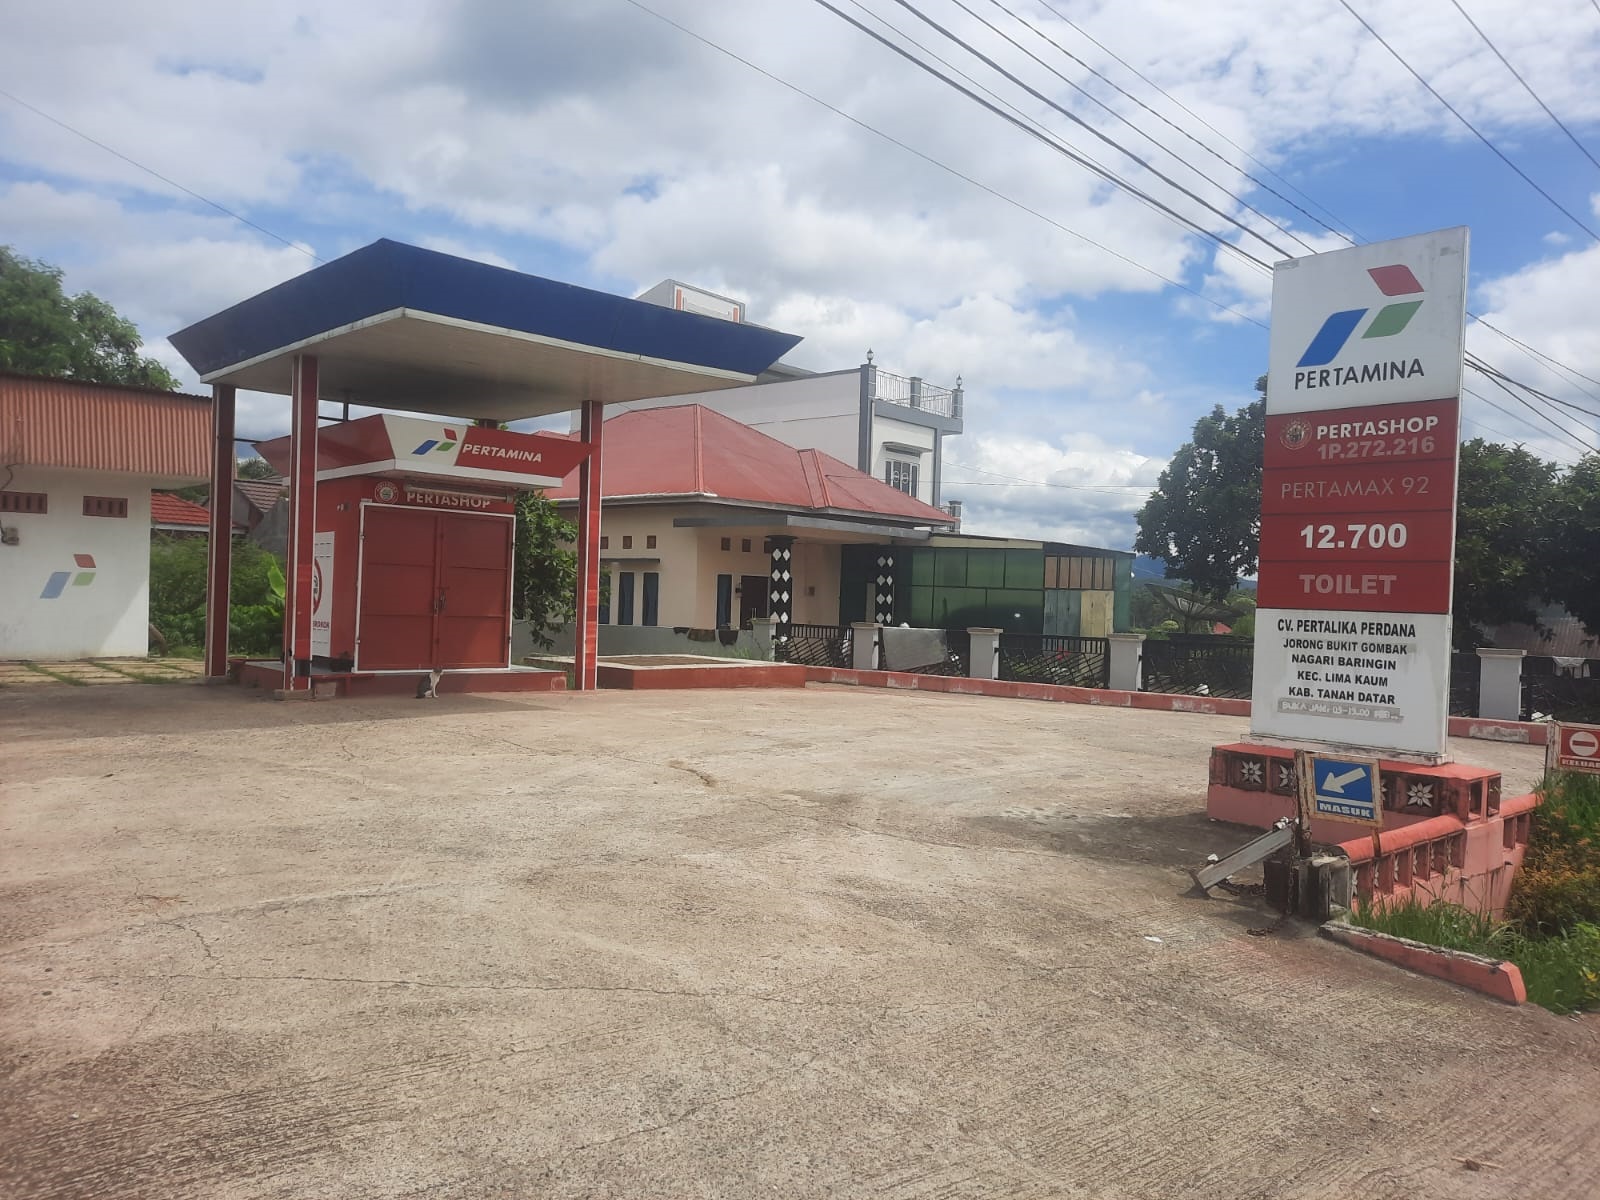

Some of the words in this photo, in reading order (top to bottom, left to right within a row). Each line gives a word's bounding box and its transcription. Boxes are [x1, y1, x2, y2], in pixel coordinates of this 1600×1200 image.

[1294, 358, 1425, 390] PERTAMINA
[1317, 415, 1439, 440] PERTASHOP
[462, 443, 542, 463] PERTAMINA
[1317, 436, 1435, 460] 1P.272.216
[1281, 478, 1395, 499] PERTAMAX
[1401, 476, 1430, 495] 92
[406, 491, 491, 509] PERTASHOP
[1300, 523, 1407, 549] 12.700
[1299, 574, 1397, 595] TOILET
[1277, 619, 1294, 632] CV.
[1296, 620, 1358, 635] PERTALIKA
[1361, 622, 1416, 638] PERDANA
[1283, 638, 1323, 650] JORONG
[1326, 641, 1358, 652] BUKIT
[1361, 643, 1408, 655] GOMBAK
[1291, 654, 1334, 666] NAGARI
[1338, 657, 1397, 670] BARINGIN
[1297, 671, 1322, 682] KEC.
[1325, 673, 1351, 684] LIMA
[1355, 675, 1388, 687] KAUM
[1288, 687, 1314, 698] KAB.
[1317, 689, 1354, 701] TANAH
[1358, 692, 1395, 705] DATAR
[1319, 802, 1371, 818] MASUK
